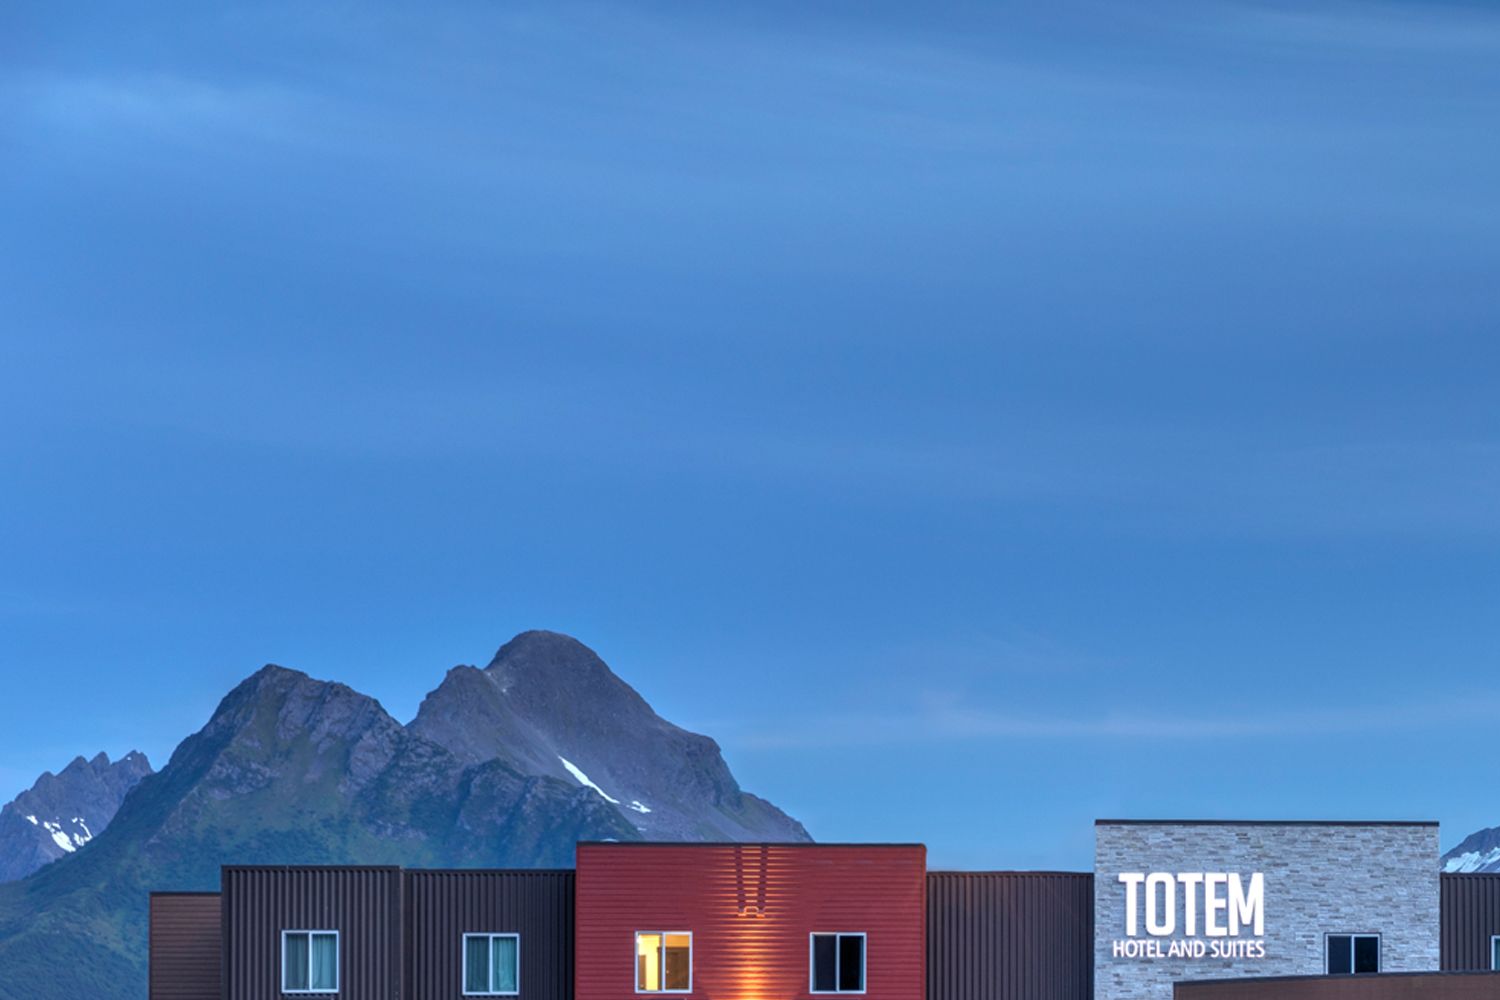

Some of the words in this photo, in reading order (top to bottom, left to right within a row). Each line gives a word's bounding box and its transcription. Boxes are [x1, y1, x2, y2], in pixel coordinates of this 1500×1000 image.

[1118, 872, 1265, 937] TOTEM
[1112, 940, 1165, 958] HOTEL
[1168, 940, 1206, 958] AND
[1210, 940, 1265, 958] SUITES
